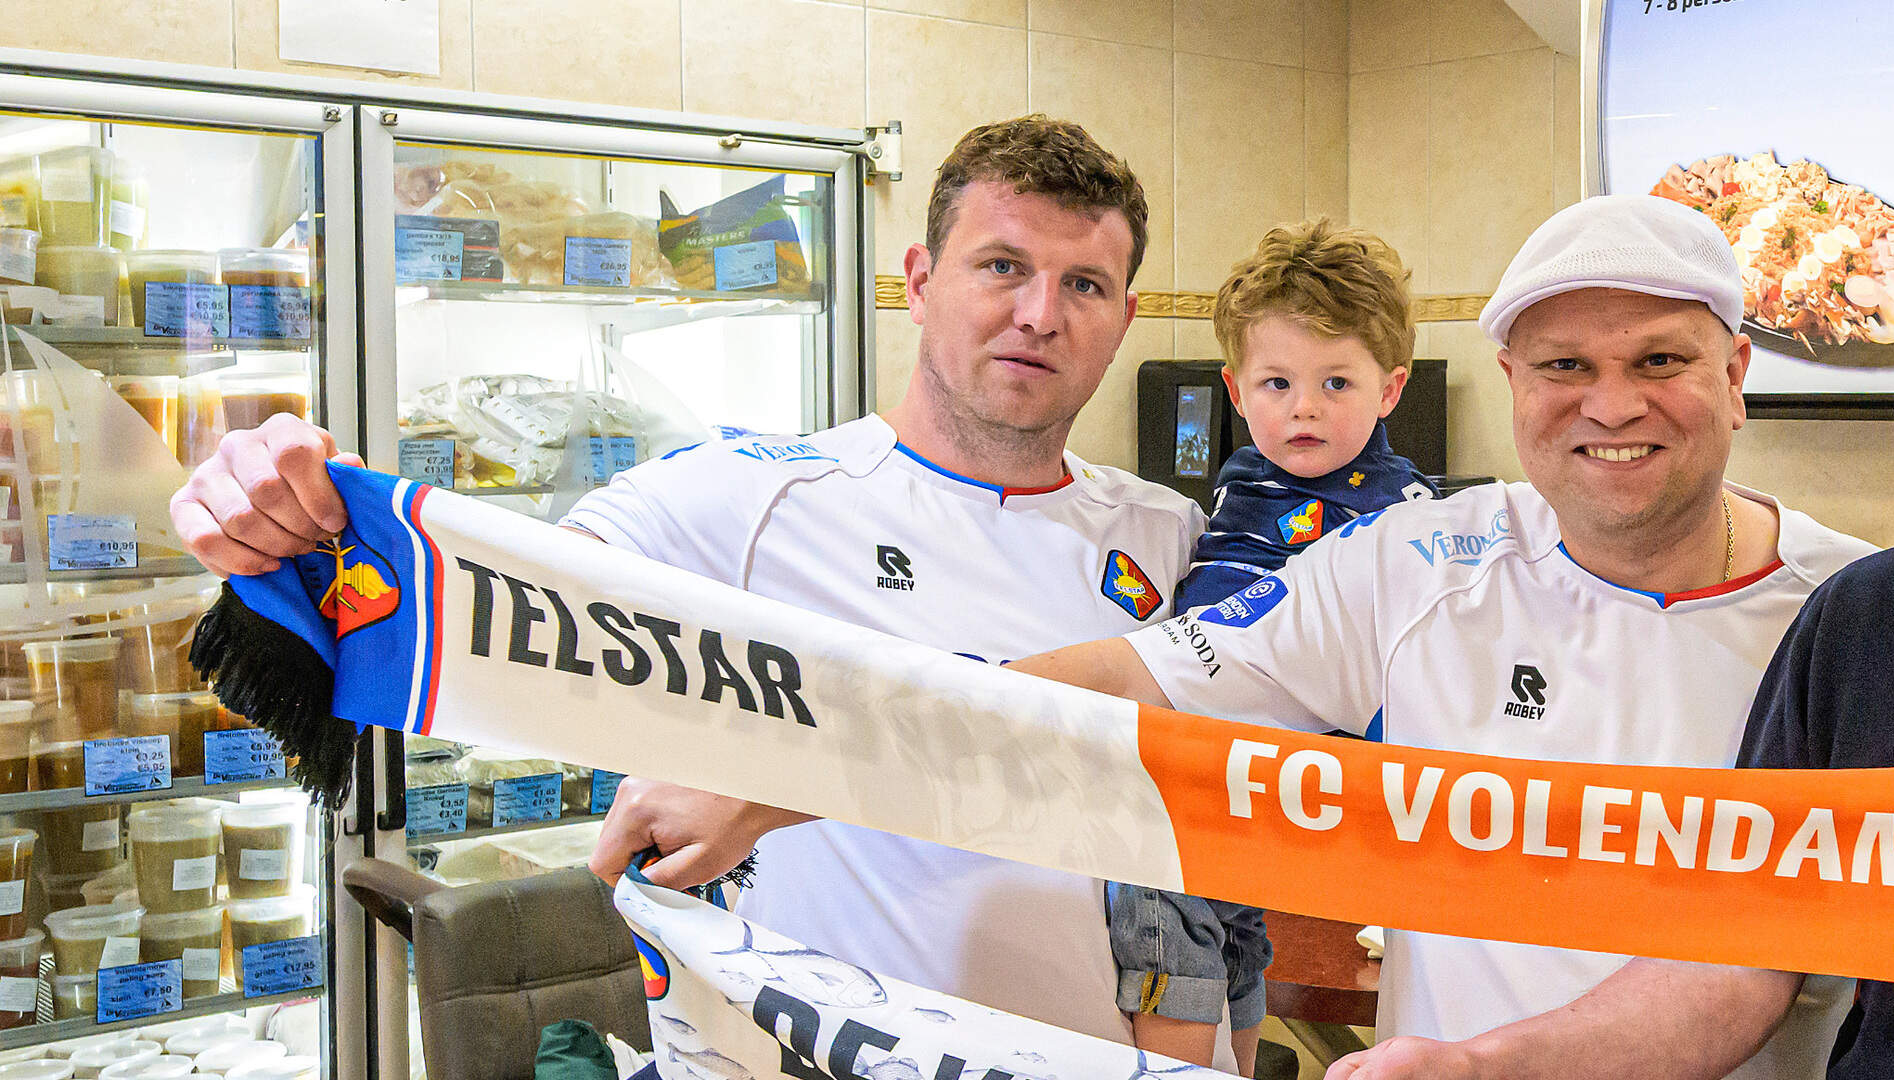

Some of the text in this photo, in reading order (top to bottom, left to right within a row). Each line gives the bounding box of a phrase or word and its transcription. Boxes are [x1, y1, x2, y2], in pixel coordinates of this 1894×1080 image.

[1407, 509, 1512, 568] VERONIC
[876, 576, 914, 592] ROBEY
[455, 555, 818, 729] TELSTAR
[1184, 622, 1222, 680] SODA
[1503, 700, 1546, 721] ROBEY
[1224, 737, 1344, 833] FC
